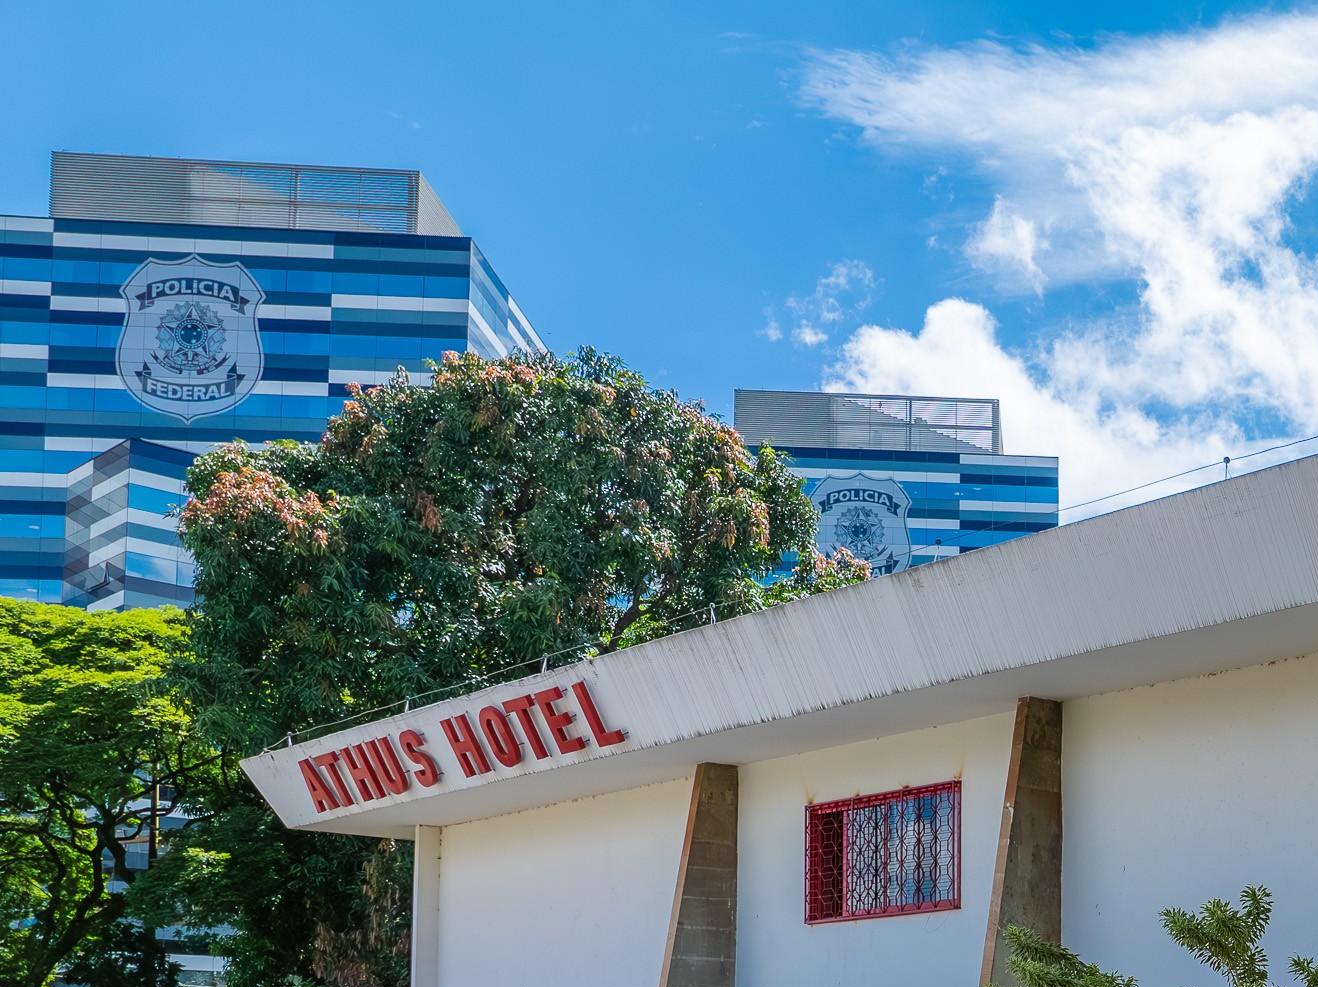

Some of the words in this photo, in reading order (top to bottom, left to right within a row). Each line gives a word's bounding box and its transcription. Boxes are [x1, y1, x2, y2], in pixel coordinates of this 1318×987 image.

[146, 380, 231, 400] FEDERAL
[298, 729, 439, 813] ATHUS
[439, 681, 626, 778] HOTEL
